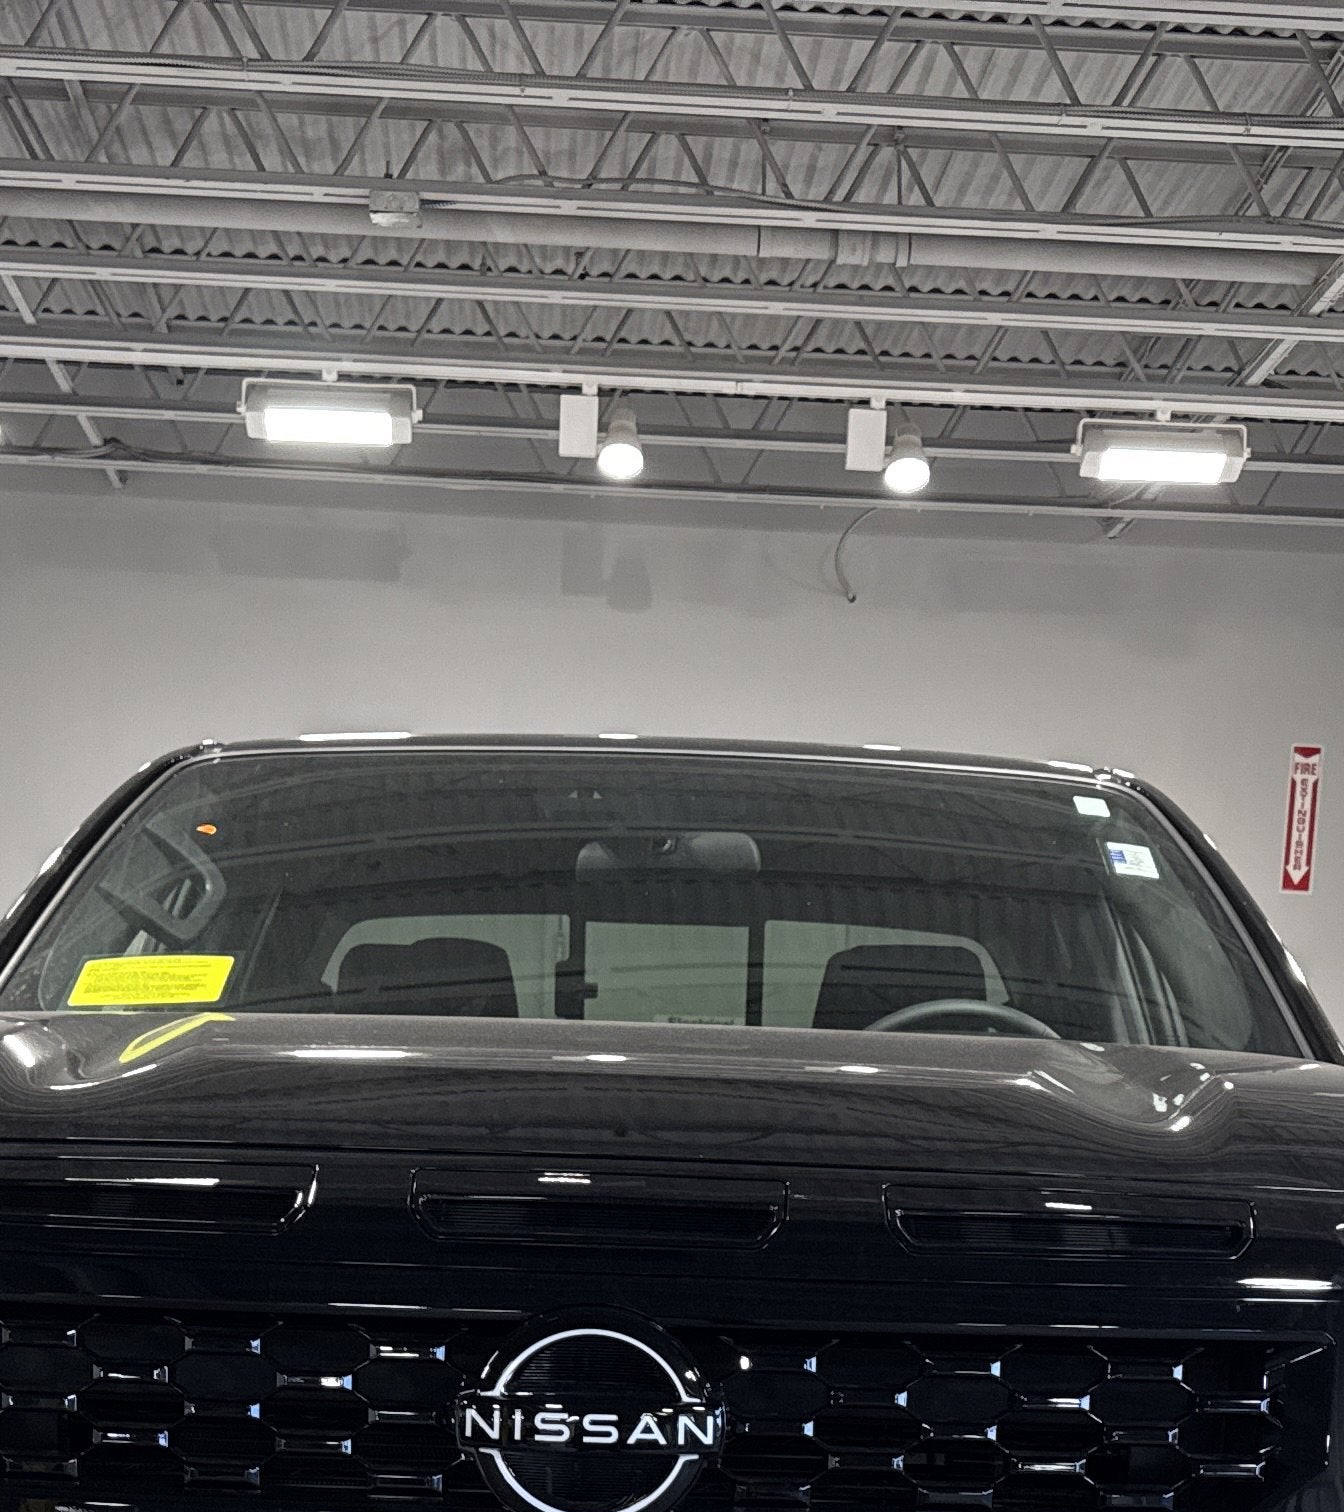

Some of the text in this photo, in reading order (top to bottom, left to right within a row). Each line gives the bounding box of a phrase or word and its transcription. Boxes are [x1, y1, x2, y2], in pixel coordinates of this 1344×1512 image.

[1294, 762, 1317, 776] FIRE
[1292, 778, 1309, 870] EXTINGUISHER
[464, 1407, 714, 1445] NISSAN
